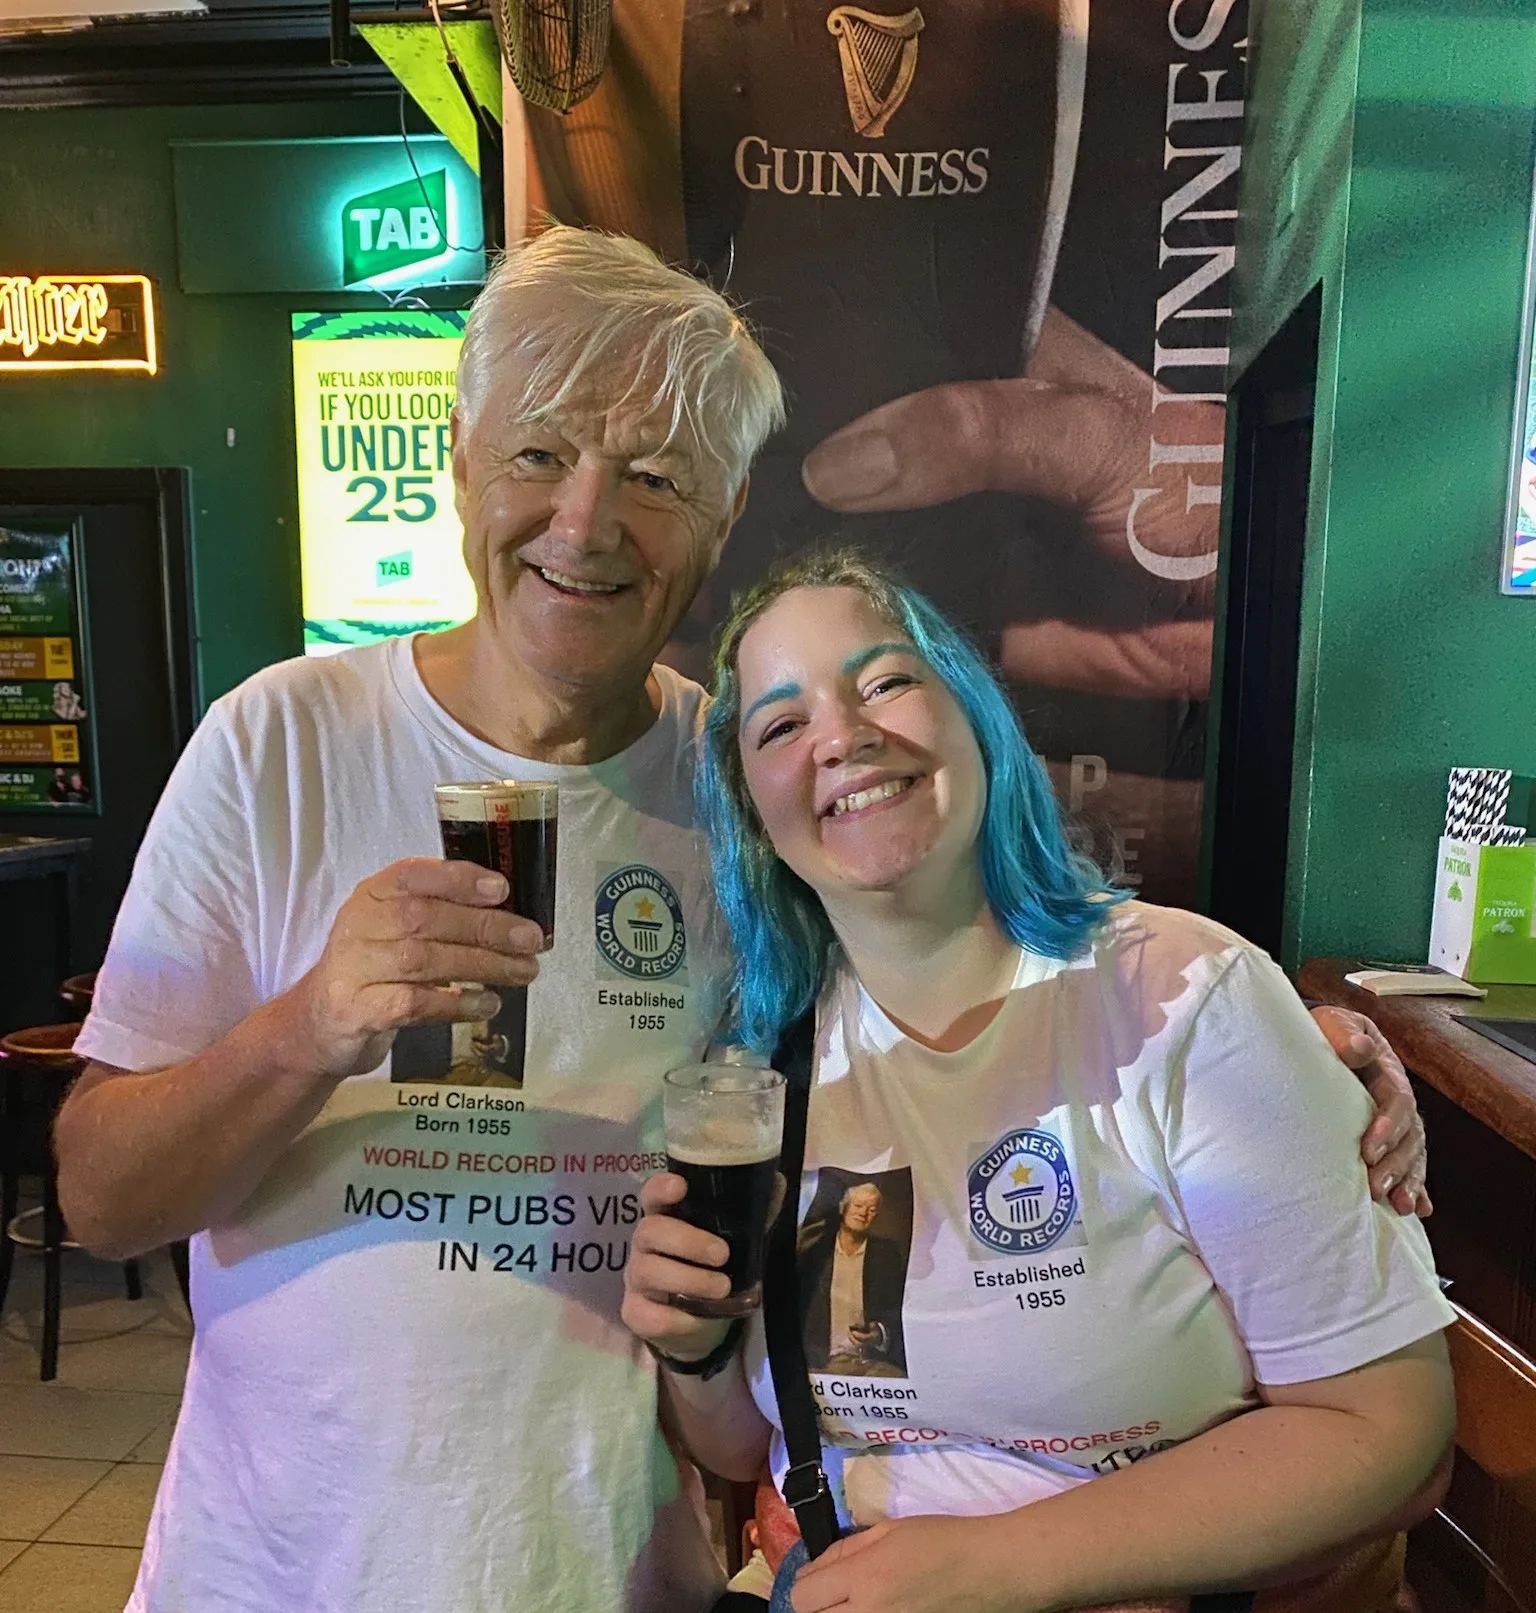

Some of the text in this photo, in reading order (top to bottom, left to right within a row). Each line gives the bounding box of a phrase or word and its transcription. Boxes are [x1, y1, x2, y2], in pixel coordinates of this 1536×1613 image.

[734, 135, 990, 197] GUINNESS
[349, 206, 440, 251] TAB
[318, 371, 355, 387] WE'LL
[359, 371, 384, 387] ASK
[388, 371, 413, 387] YOU
[417, 370, 442, 386] FOR
[320, 394, 338, 420] IF
[345, 393, 391, 420] YOU
[345, 476, 437, 523] 25
[378, 562, 411, 576] TAB
[605, 871, 675, 908] GUINNESS
[597, 912, 685, 974] WORLD RECORDS
[598, 989, 684, 1010] Established
[629, 1013, 665, 1030] 1955
[398, 1090, 525, 1113] Lord Clarkson
[415, 1115, 511, 1136] Born 1955
[363, 1144, 667, 1174] WORLD RECORD IN PROGRES
[978, 1135, 1060, 1178] GUINNESS
[344, 1183, 455, 1224] MOST
[467, 1194, 576, 1226] PUBS
[971, 1170, 1071, 1248] WORLD RECORDS
[438, 1241, 627, 1273] IN 24 HOU
[973, 1257, 1086, 1288] Established
[1015, 1289, 1066, 1310] 1955
[831, 1380, 918, 1400] Clarkson
[860, 1405, 909, 1420] 1955
[1013, 1420, 1161, 1454] PROGRESS
